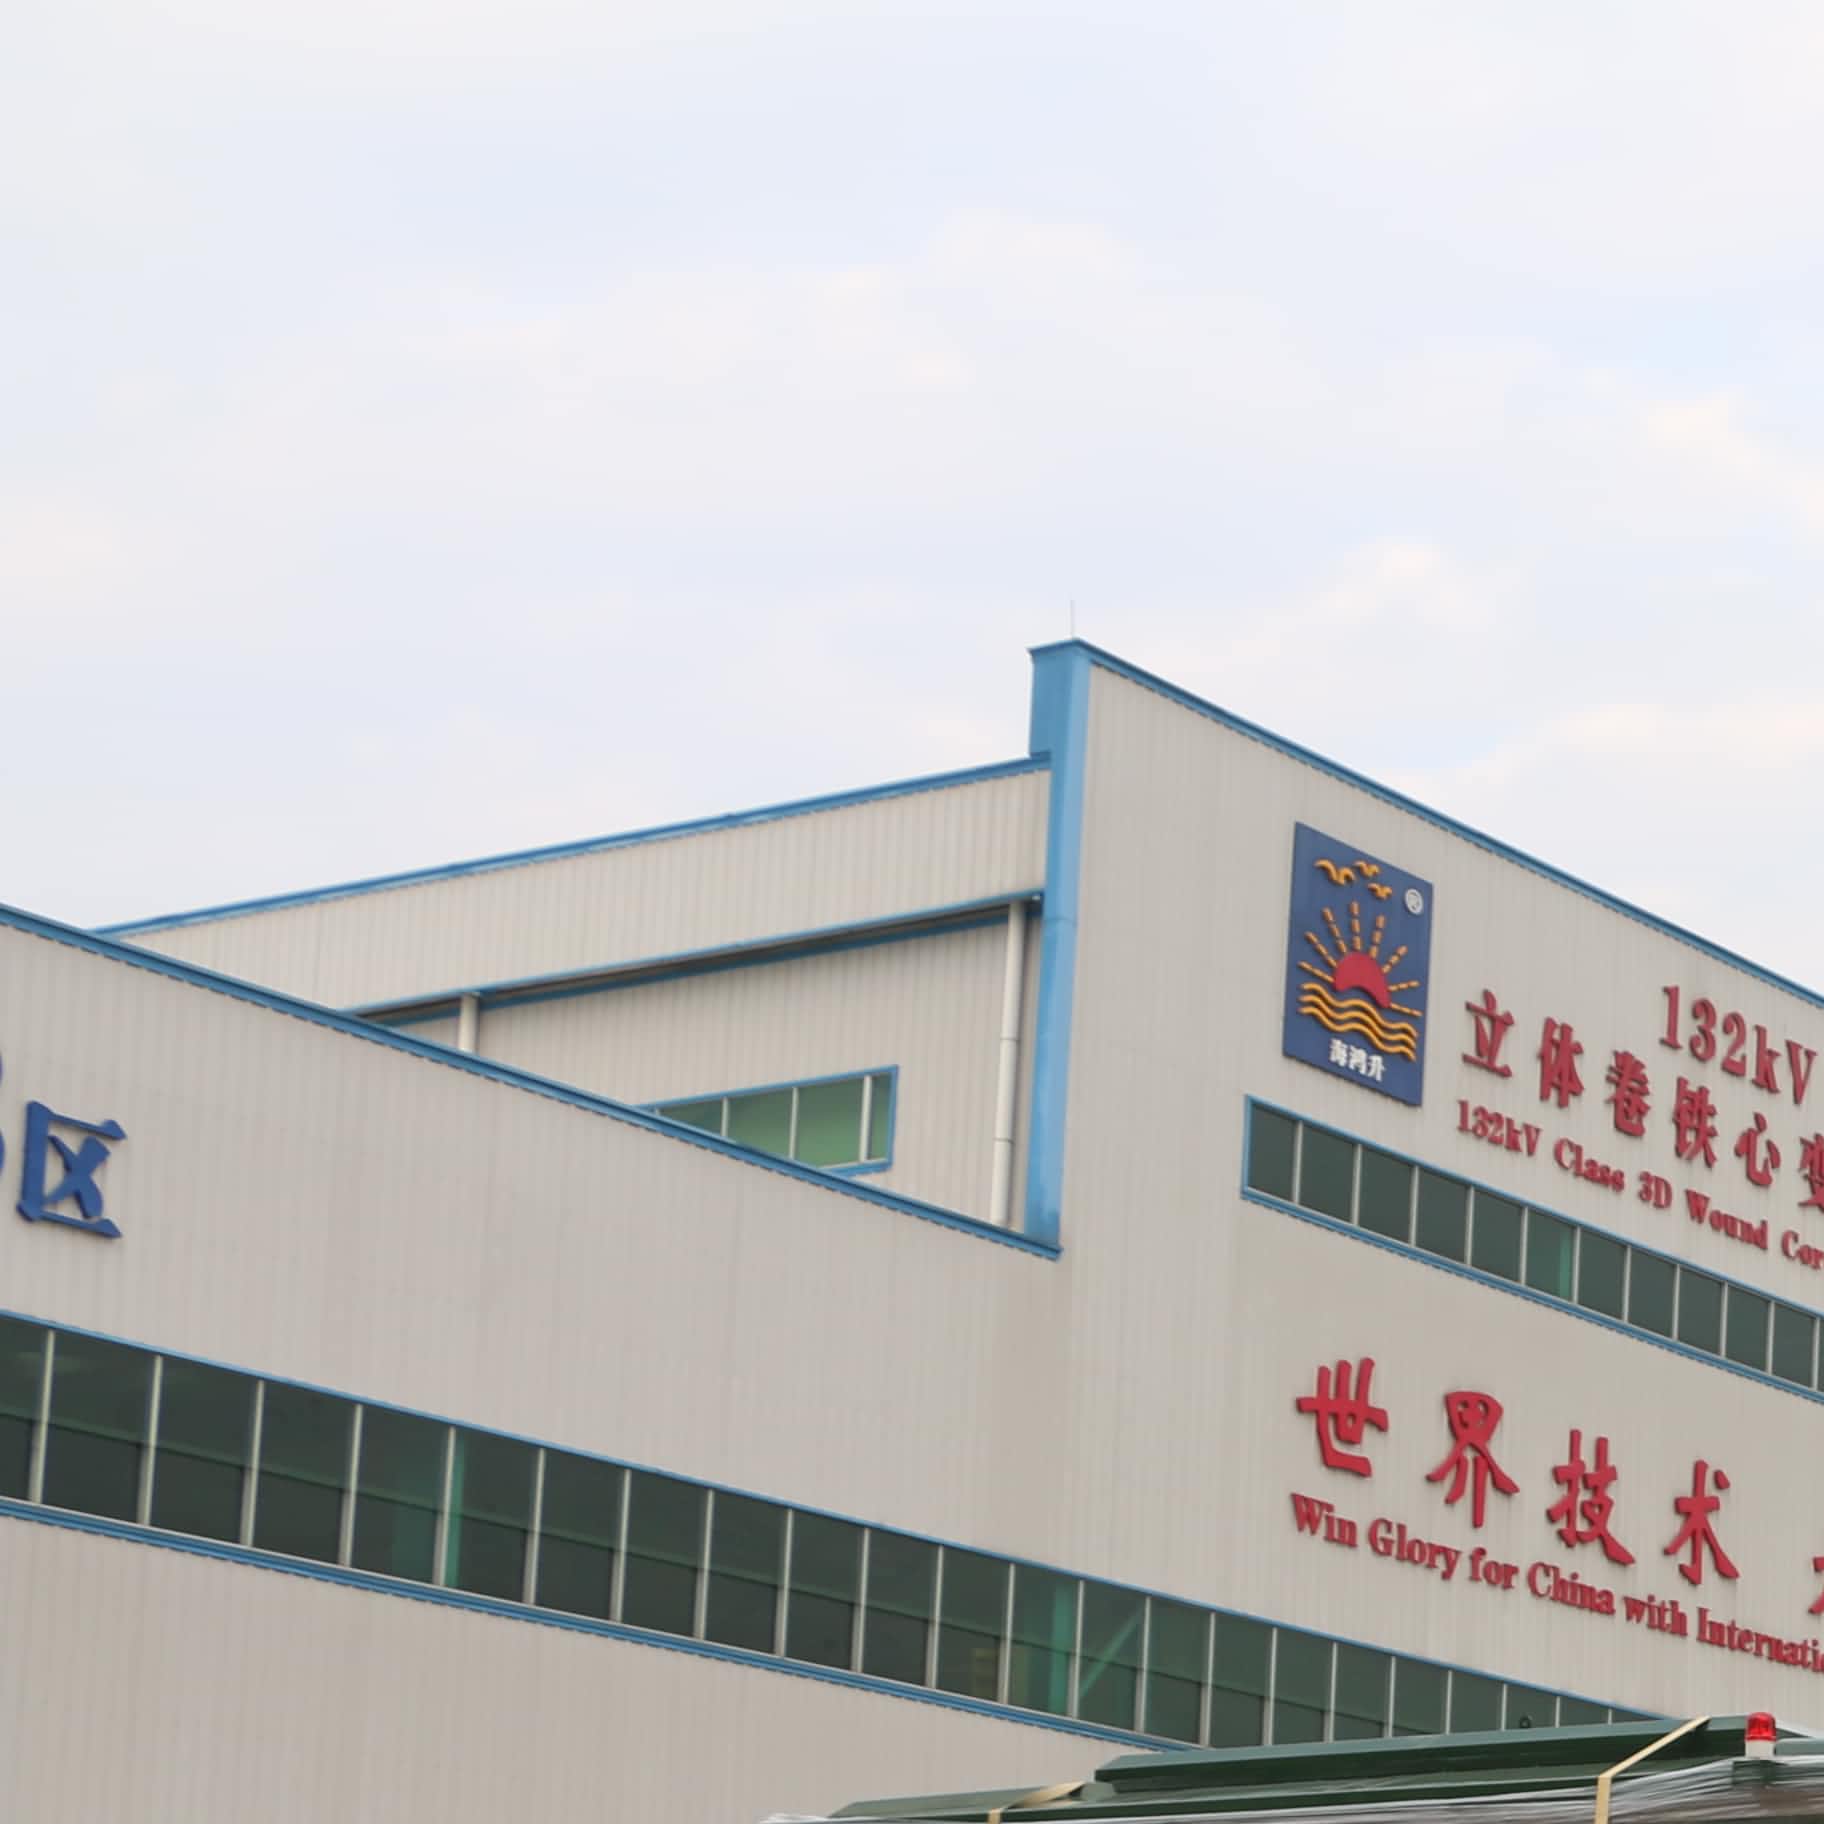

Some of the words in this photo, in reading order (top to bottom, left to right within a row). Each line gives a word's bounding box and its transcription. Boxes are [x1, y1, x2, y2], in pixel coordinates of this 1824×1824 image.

[1457, 1099, 1541, 1158] 132kV
[1554, 1137, 1625, 1193] Class
[1638, 1170, 1673, 1209] 3D
[1685, 1187, 1768, 1250] Wound
[1296, 1356, 1739, 1585] 世界技术
[1290, 1492, 1358, 1549] Win
[1368, 1517, 1462, 1581] Glory
[1470, 1547, 1520, 1590] for
[1527, 1561, 1616, 1616] China
[1624, 1595, 1688, 1638] with
